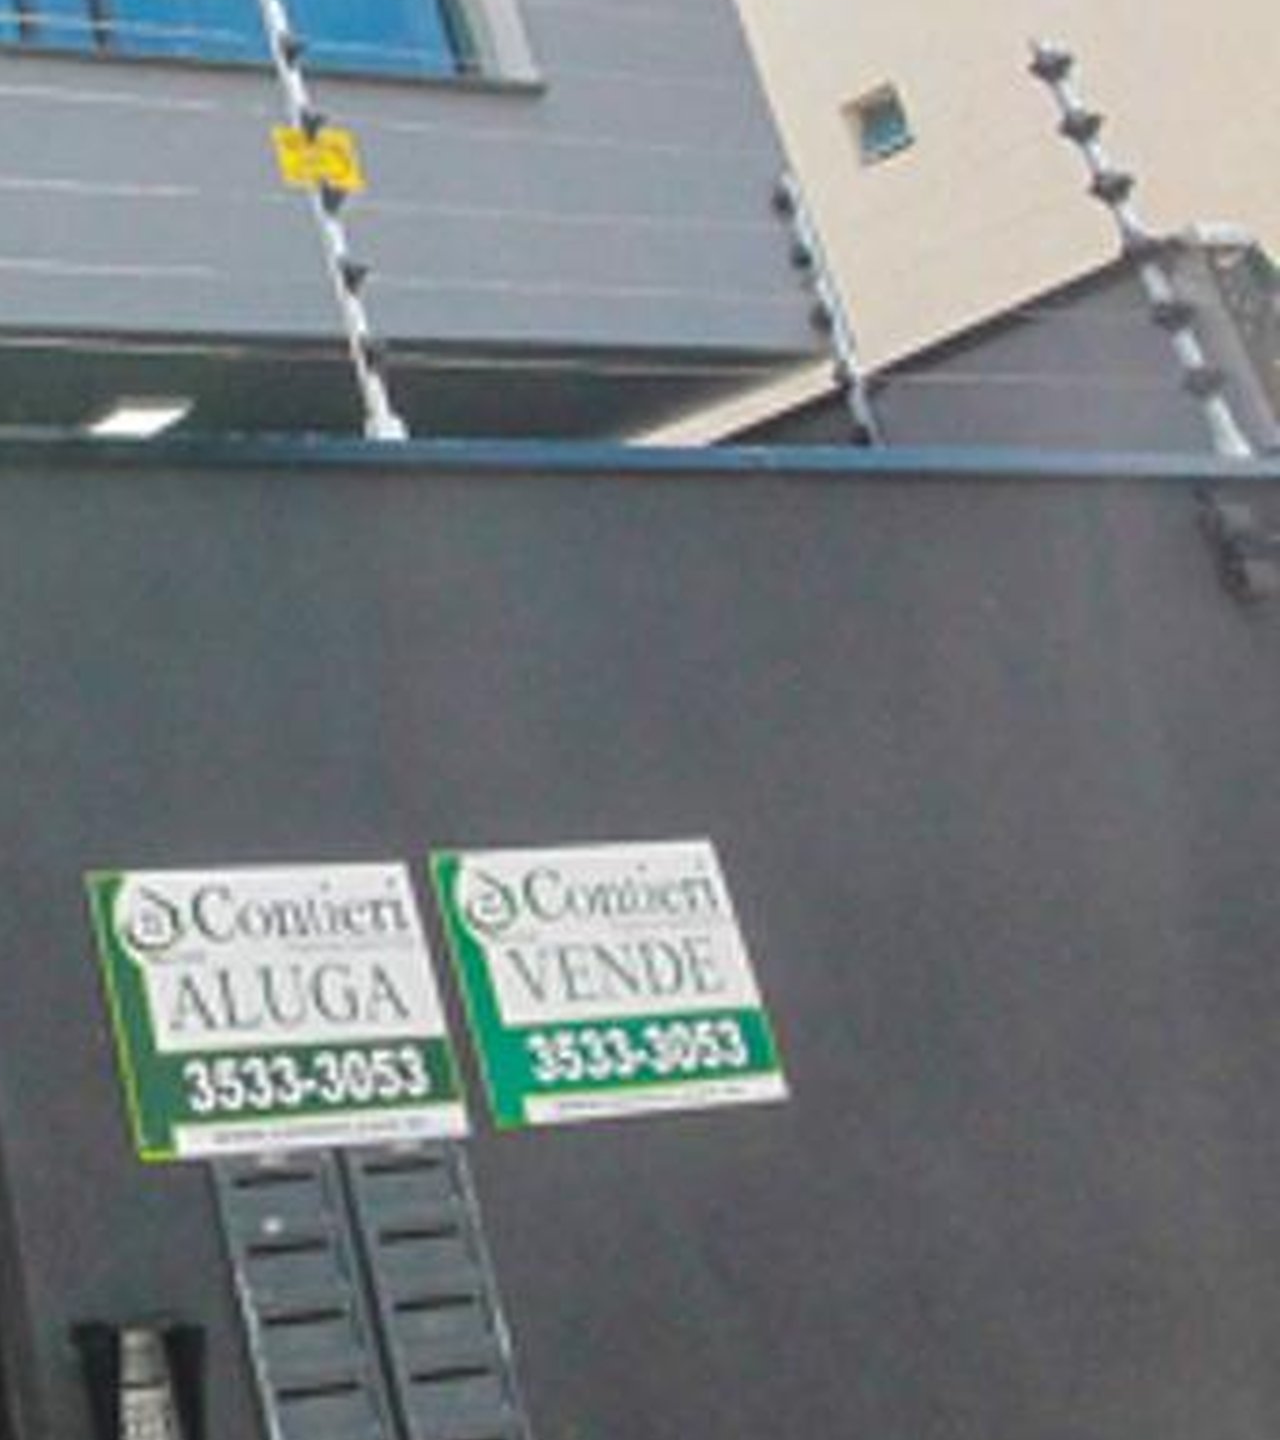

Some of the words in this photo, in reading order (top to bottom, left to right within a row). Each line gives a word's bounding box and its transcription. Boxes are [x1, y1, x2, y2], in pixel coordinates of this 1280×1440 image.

[168, 963, 412, 1032] ALUGA
[505, 935, 726, 1004] VENDE
[183, 1045, 430, 1113] 3533-3053
[525, 1017, 749, 1083] 3533-3053
